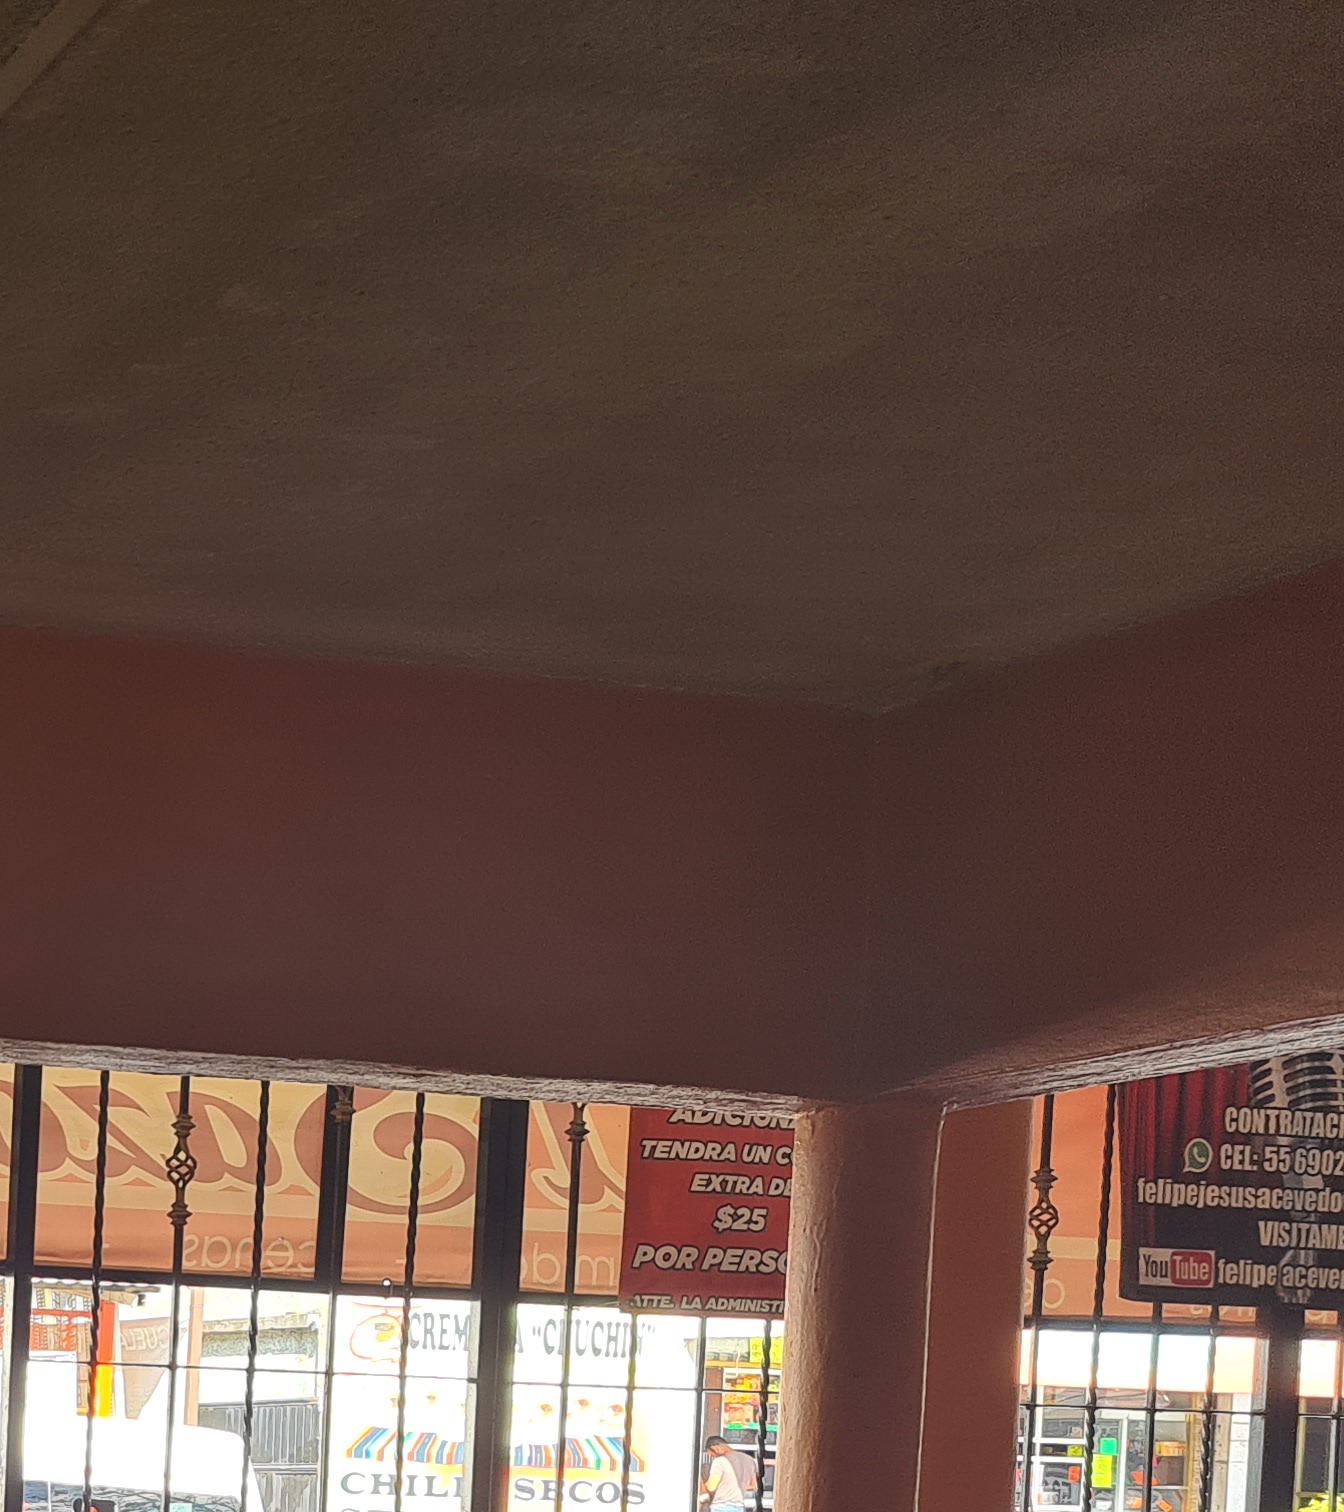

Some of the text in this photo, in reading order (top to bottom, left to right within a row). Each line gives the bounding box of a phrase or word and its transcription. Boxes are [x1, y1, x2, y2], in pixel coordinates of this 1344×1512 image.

[641, 1139, 738, 1162] TENDRA
[742, 1143, 773, 1165] UN
[1220, 1143, 1259, 1172] CEL:
[1263, 1145, 1291, 1174] 55
[690, 1173, 764, 1196] EXTRA
[1137, 1177, 1344, 1214] felipejesusacevedo
[712, 1203, 769, 1233] $25
[632, 1244, 700, 1271] POR
[1217, 1258, 1278, 1289] felipe
[1281, 1264, 1344, 1291] aceve
[680, 1295, 703, 1311] LA
